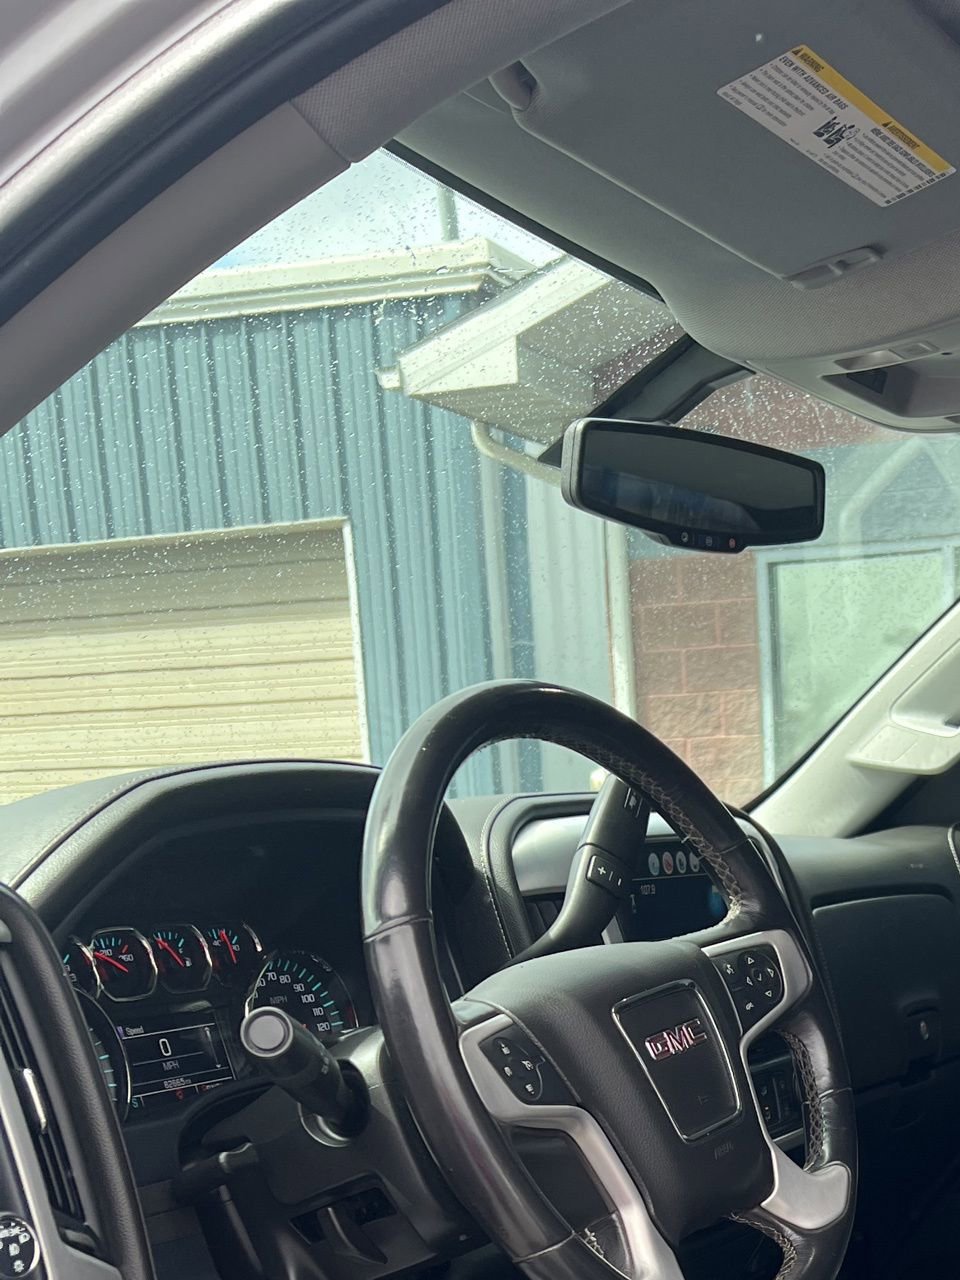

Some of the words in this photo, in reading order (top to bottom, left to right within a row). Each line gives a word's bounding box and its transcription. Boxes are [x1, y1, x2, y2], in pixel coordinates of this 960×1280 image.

[779, 55, 793, 68] EVEN
[791, 65, 807, 77] WITH
[804, 72, 830, 95] ADVANCED
[266, 972, 277, 981] 70
[279, 974, 291, 984] 80
[293, 983, 305, 993] 90
[301, 993, 315, 1004] 100
[312, 1007, 324, 1017] 110
[125, 1026, 144, 1037] Speed
[317, 1021, 331, 1032] 120
[644, 1018, 708, 1061] GMC
[162, 1060, 180, 1072] MPH
